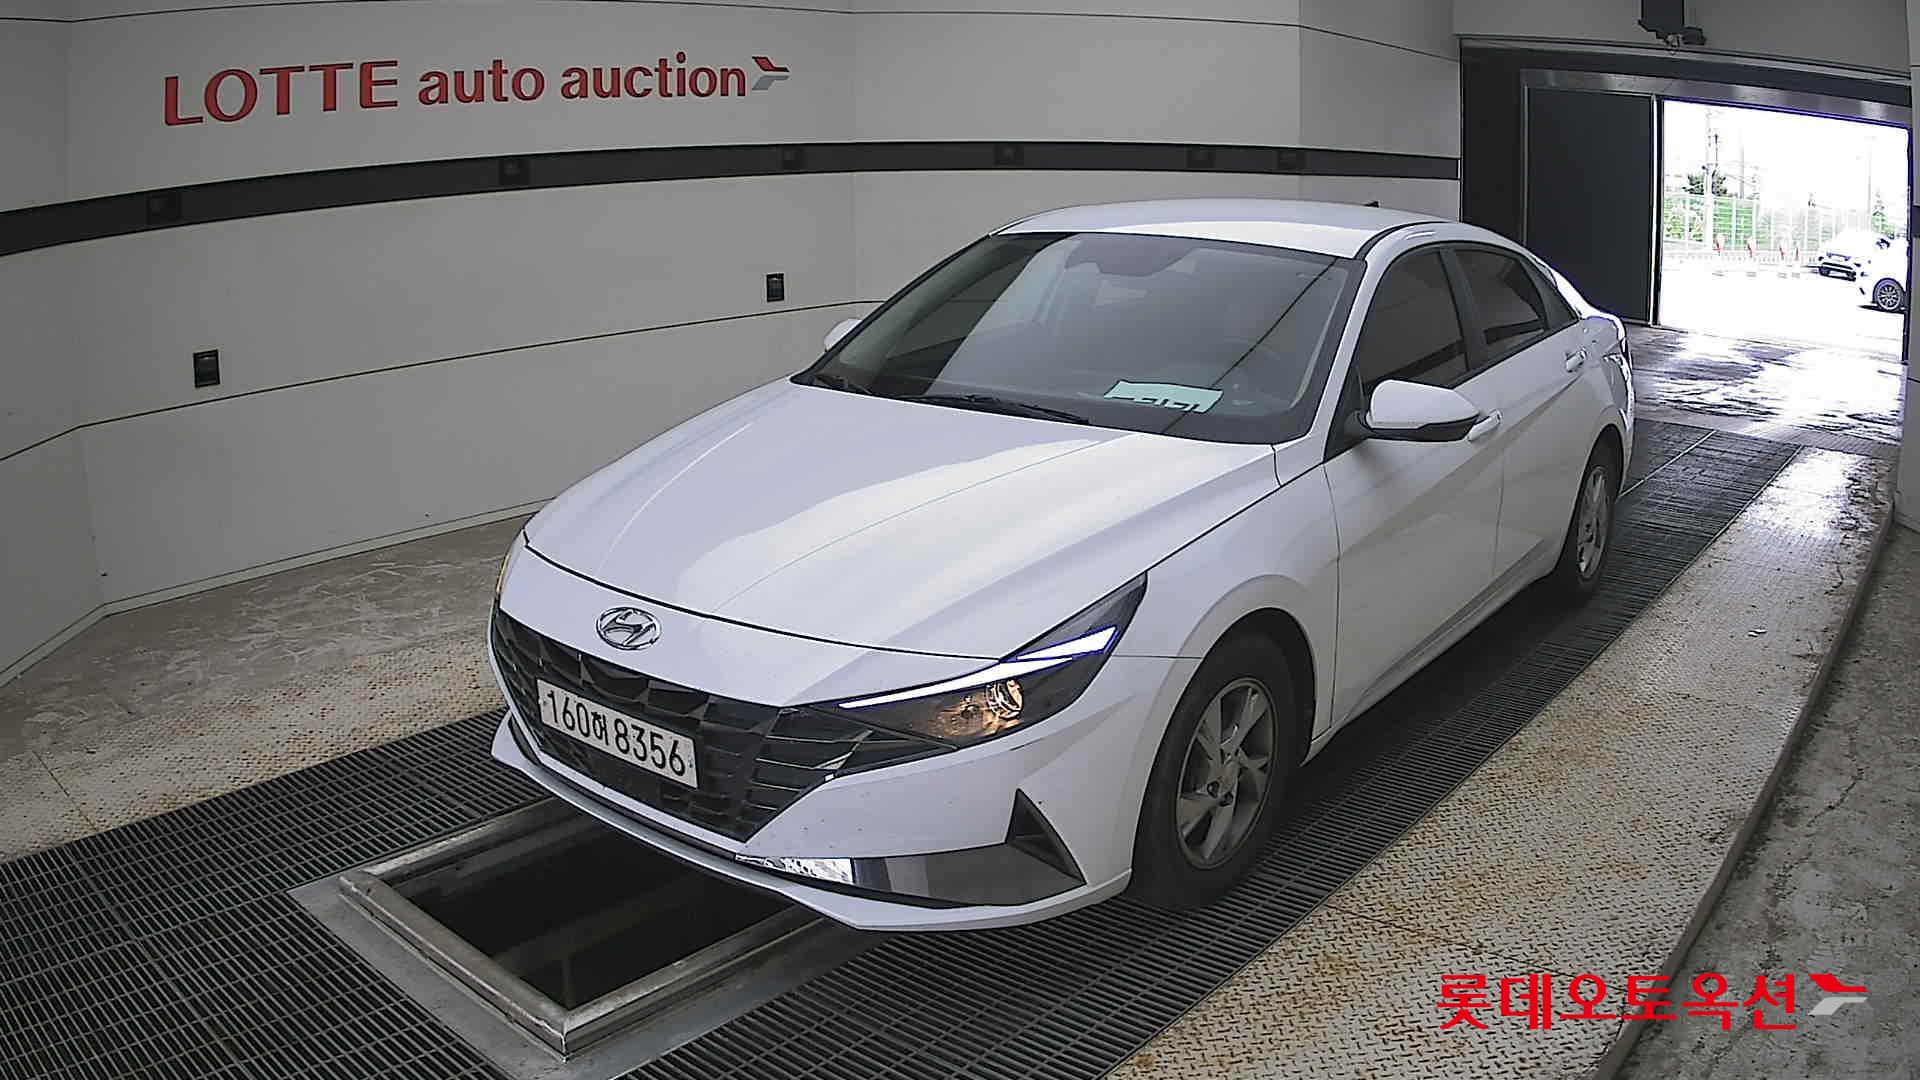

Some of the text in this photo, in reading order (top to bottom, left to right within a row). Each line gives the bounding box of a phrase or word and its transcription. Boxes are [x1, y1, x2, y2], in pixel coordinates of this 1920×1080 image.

[164, 51, 748, 126] LOTTE auto auction
